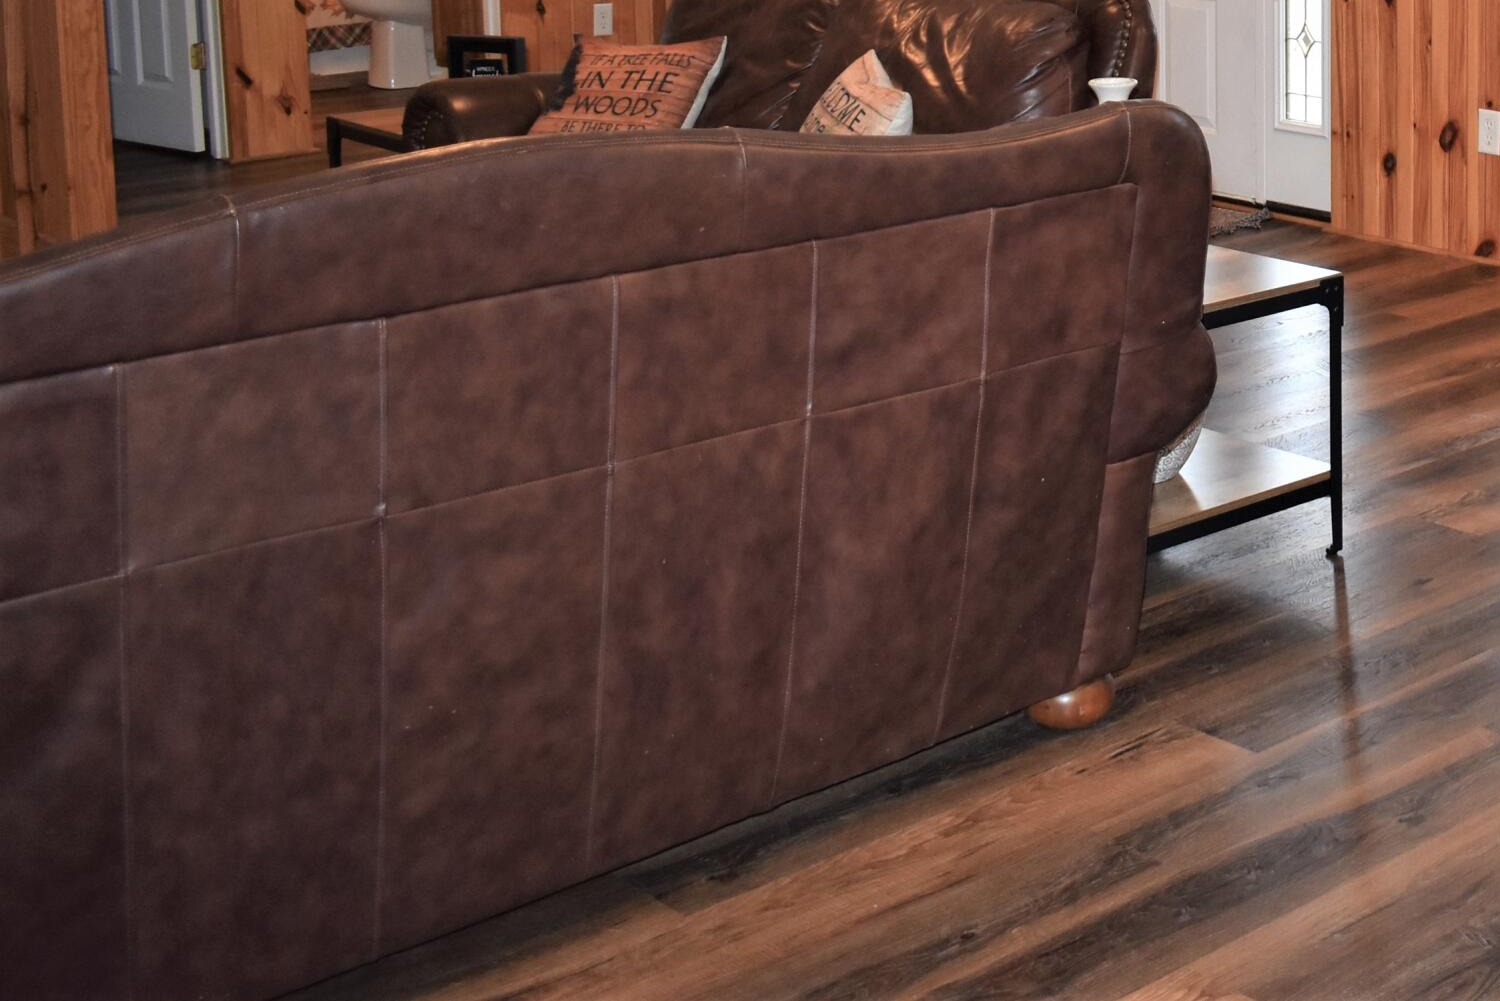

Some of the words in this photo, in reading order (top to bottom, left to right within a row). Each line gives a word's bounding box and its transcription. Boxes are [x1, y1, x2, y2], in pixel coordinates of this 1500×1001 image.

[649, 52, 696, 70] FALLS
[580, 70, 614, 89] IN
[621, 69, 680, 94] THE
[573, 95, 662, 119] WOODS
